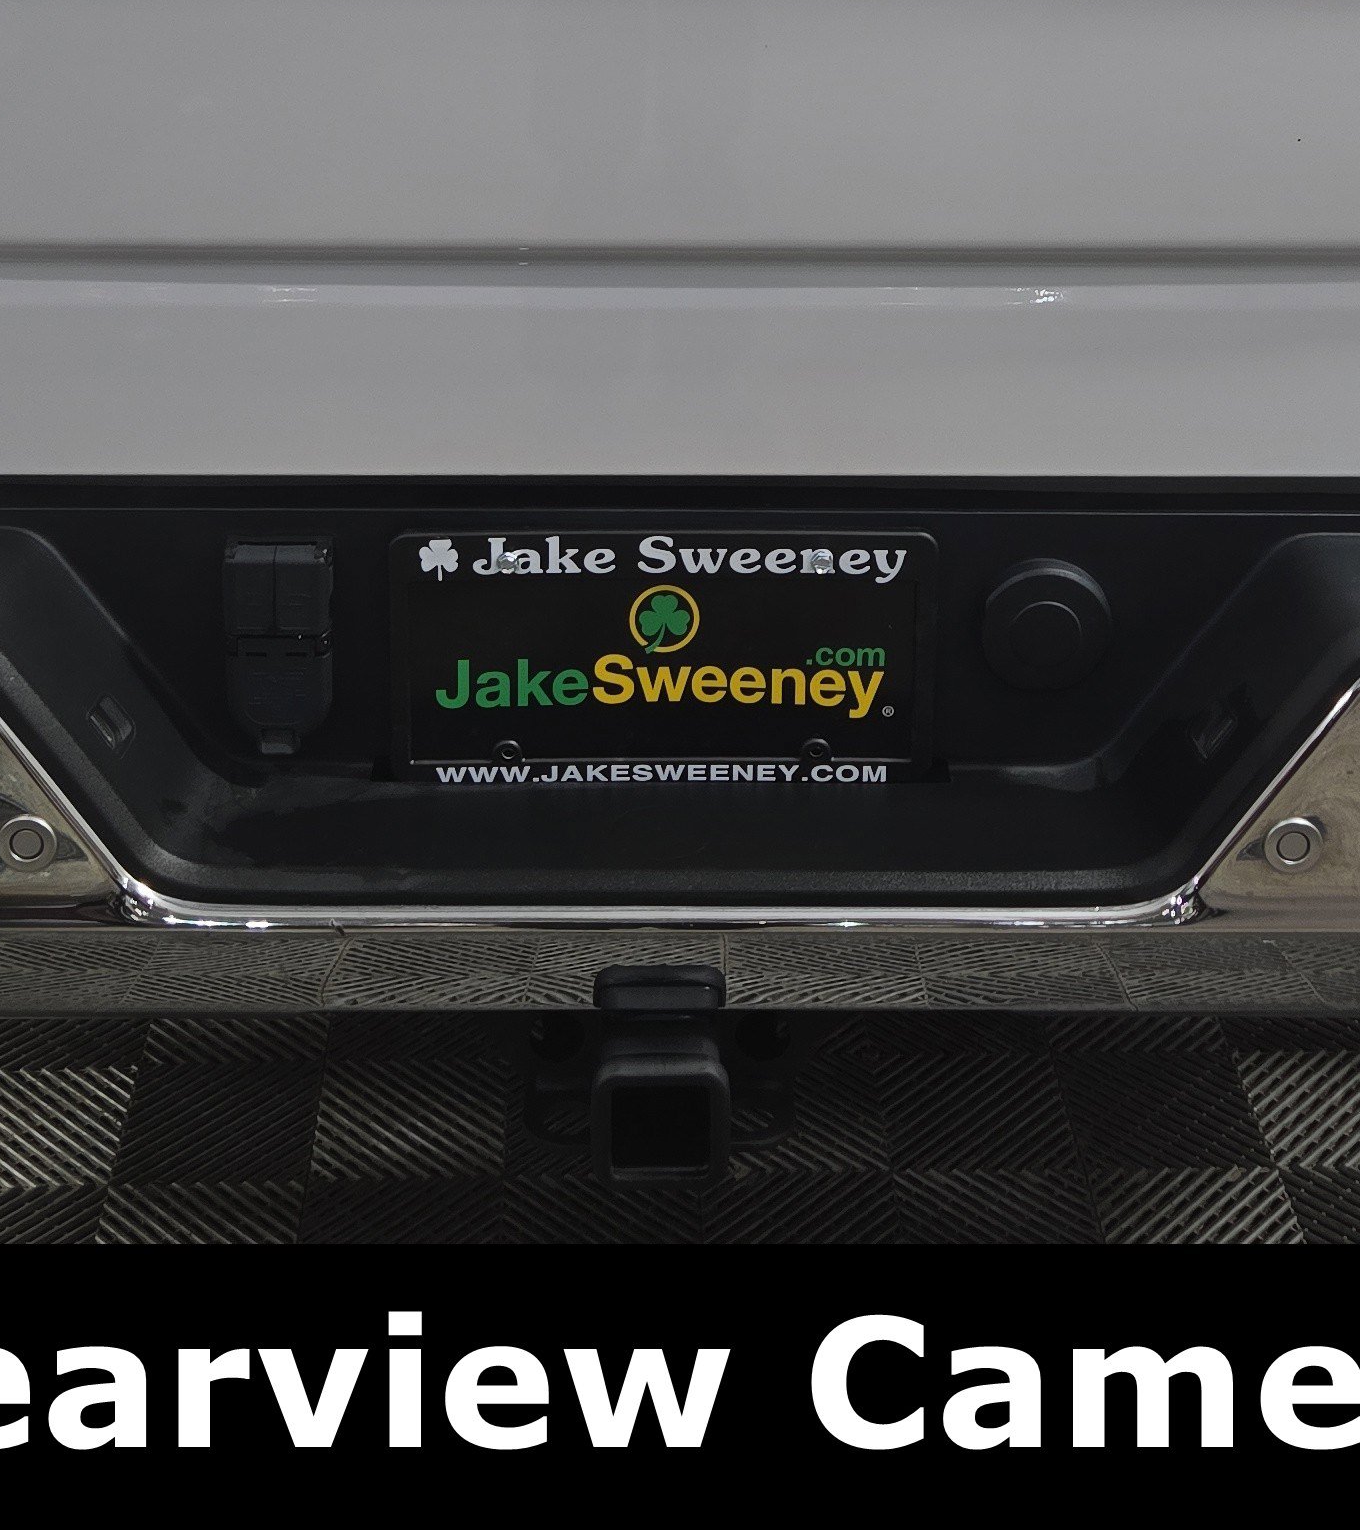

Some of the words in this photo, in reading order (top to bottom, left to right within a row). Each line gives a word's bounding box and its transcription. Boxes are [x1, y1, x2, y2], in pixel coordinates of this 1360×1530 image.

[472, 535, 616, 576] Jake
[637, 535, 908, 584] Sweeney
[435, 764, 888, 784] WWW.JAKESWEENEY.COM
